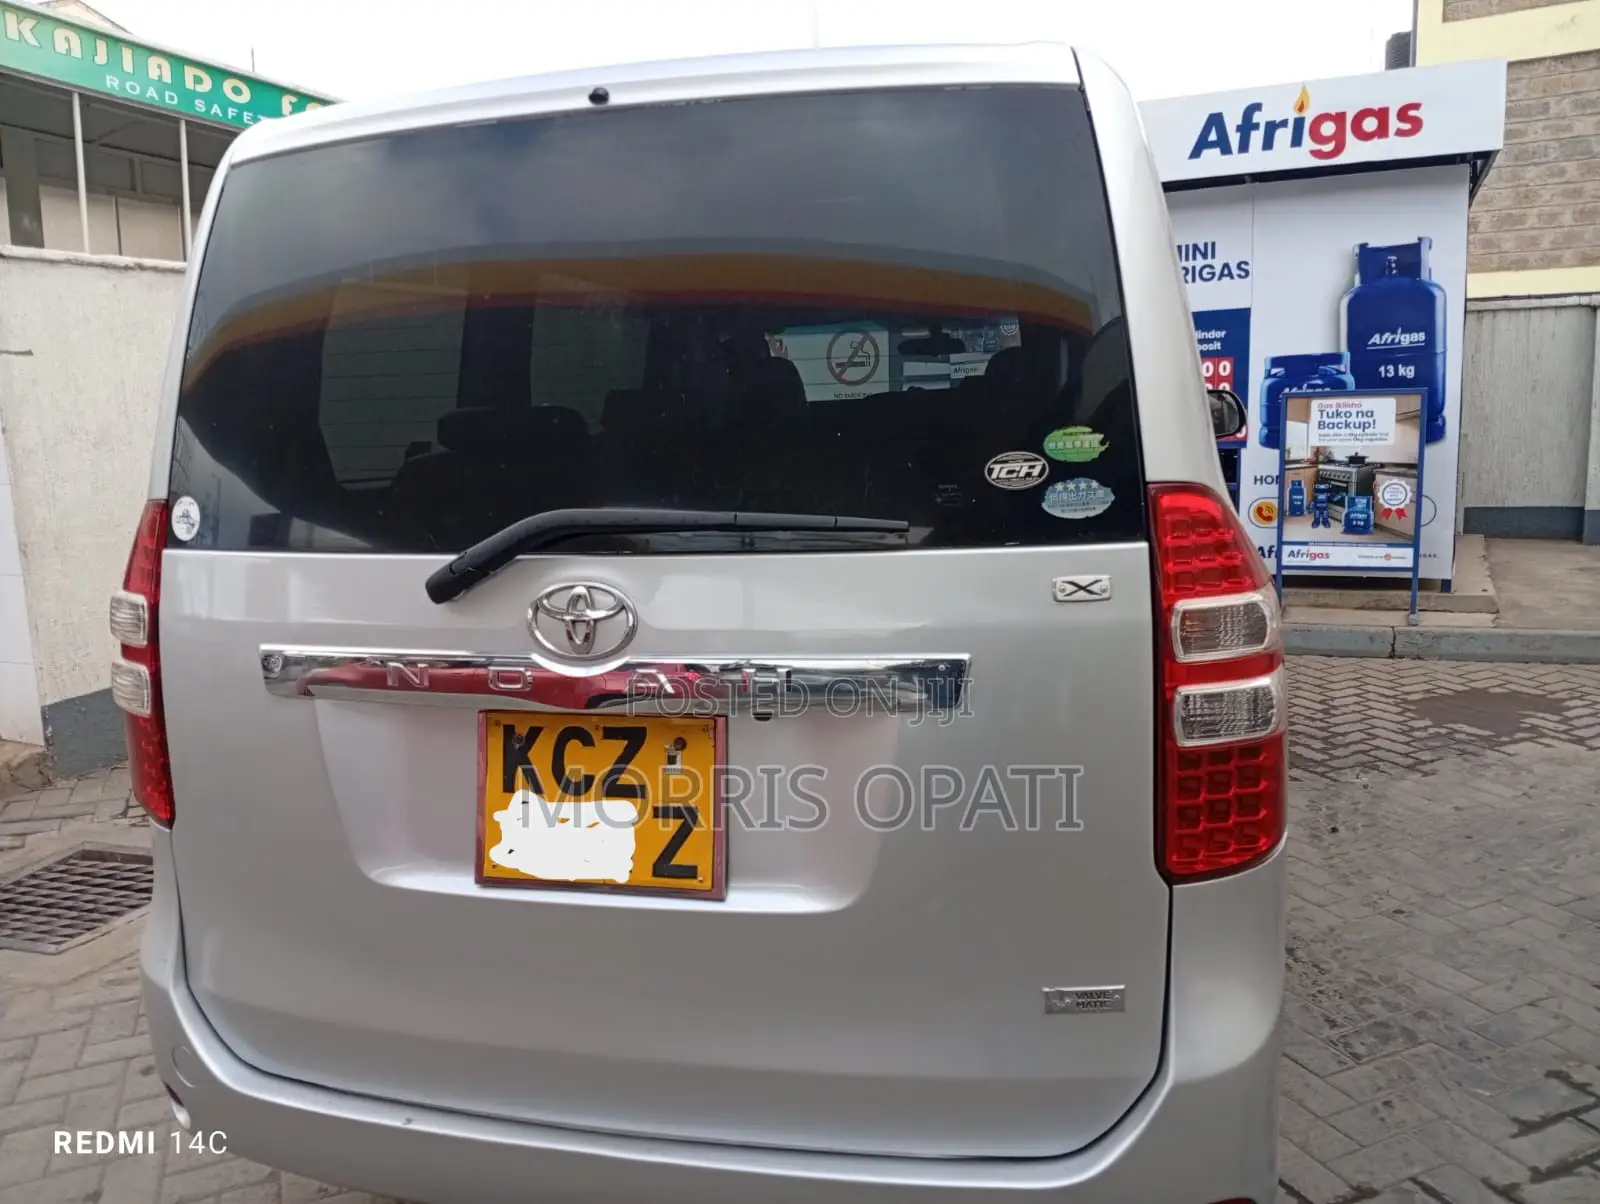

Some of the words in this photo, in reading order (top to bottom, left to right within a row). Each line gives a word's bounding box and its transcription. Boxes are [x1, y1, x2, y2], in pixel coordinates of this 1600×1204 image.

[2, 8, 251, 104] KAJIADO
[105, 74, 179, 105] ROAD
[1188, 88, 1424, 160] Afrigas
[1367, 328, 1426, 347] Afrigas
[1378, 365, 1394, 378] 13
[1398, 363, 1415, 379] kg
[1317, 409, 1353, 419] Tuko
[1355, 409, 1375, 418] na
[1317, 419, 1376, 432] Backup!
[1258, 545, 1277, 559] Af
[1287, 548, 1330, 561] Afrigas
[1061, 579, 1103, 597] X
[502, 724, 648, 799] KCZ
[652, 805, 699, 879] Z
